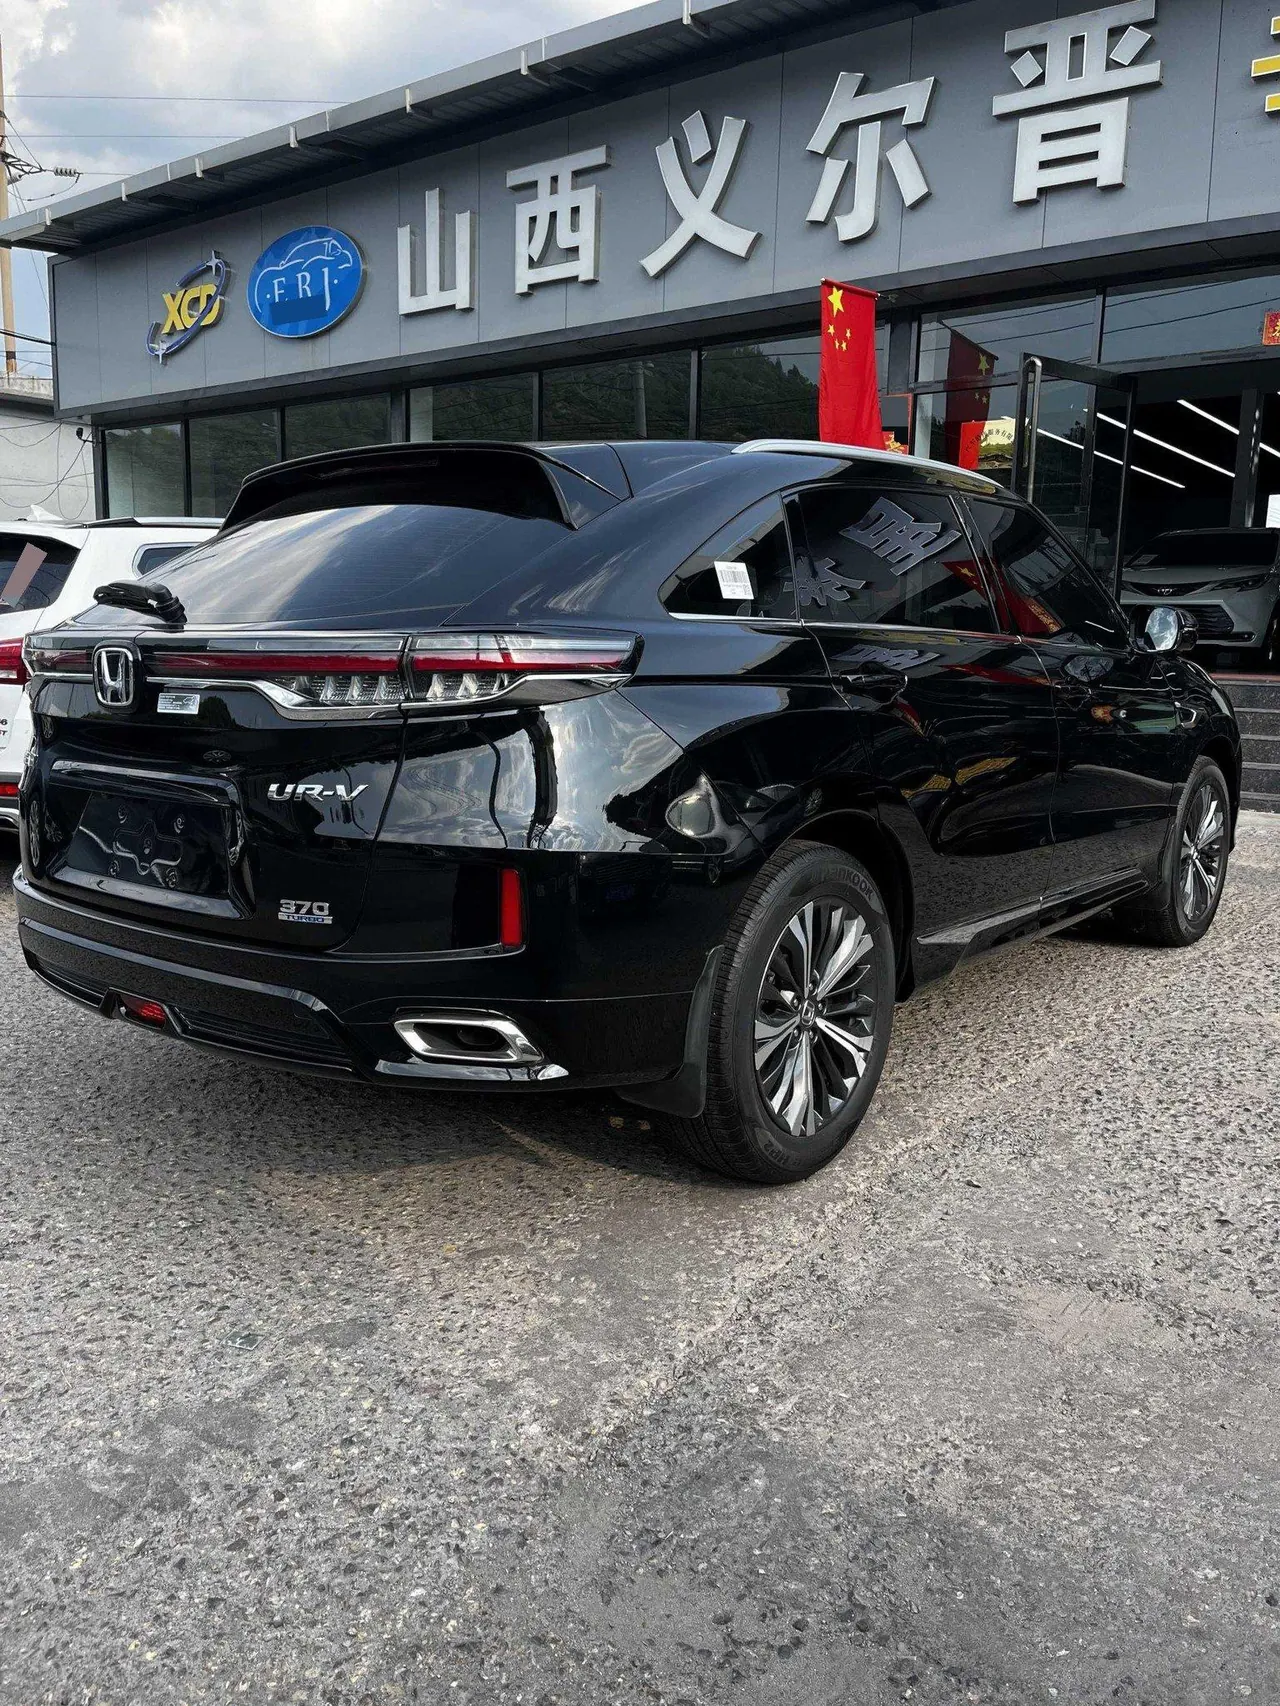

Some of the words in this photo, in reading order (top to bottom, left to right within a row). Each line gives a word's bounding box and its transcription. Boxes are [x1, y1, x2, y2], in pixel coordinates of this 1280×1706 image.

[397, 0, 1163, 316] 山西义尔晋
[267, 783, 369, 801] UR-V
[279, 899, 330, 916] 370
[285, 914, 325, 924] TURBO
